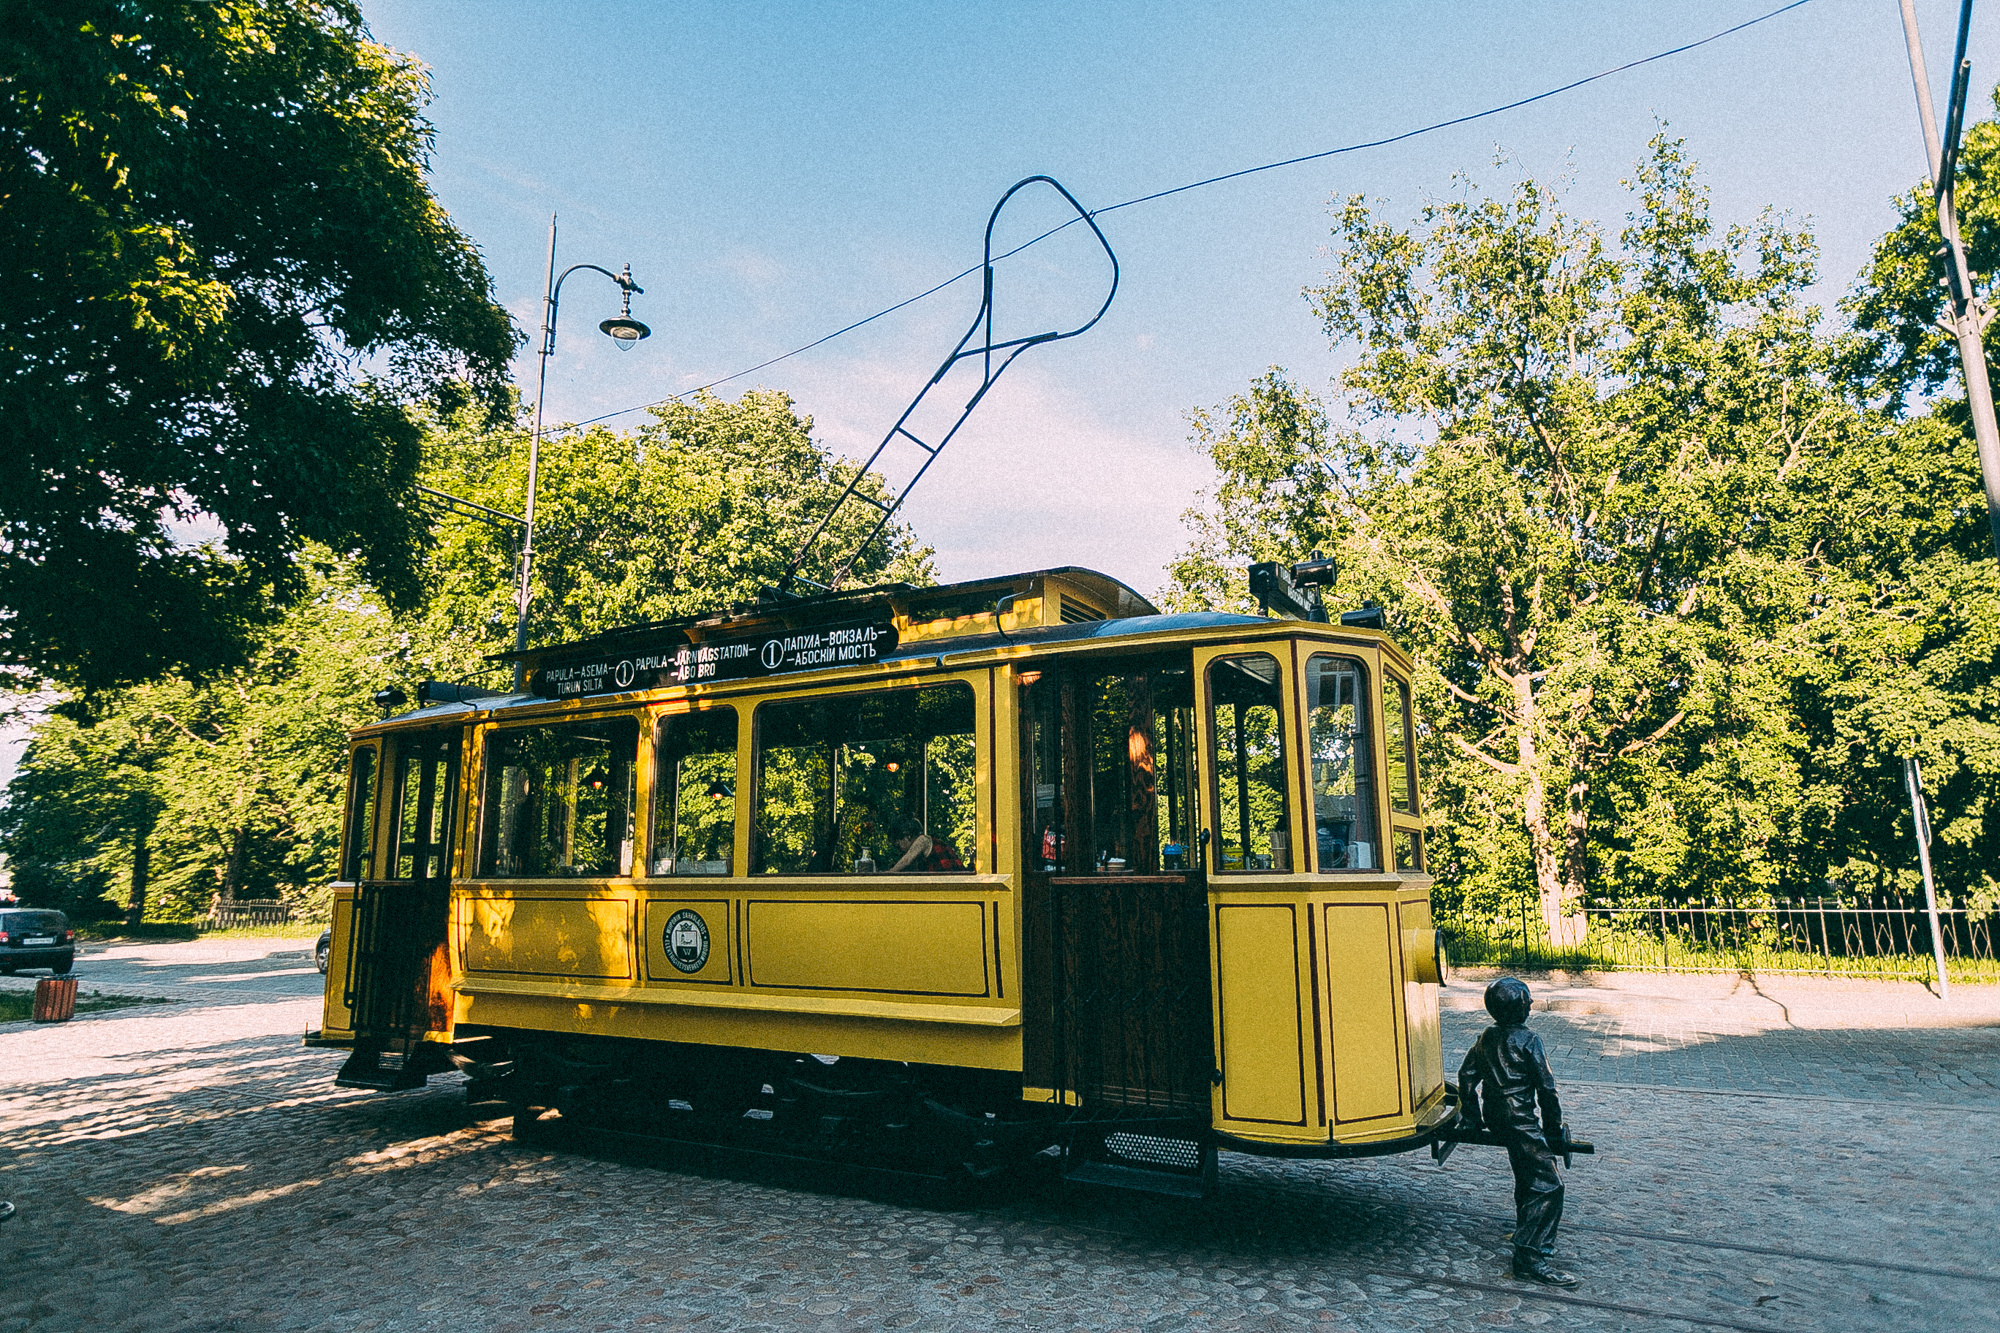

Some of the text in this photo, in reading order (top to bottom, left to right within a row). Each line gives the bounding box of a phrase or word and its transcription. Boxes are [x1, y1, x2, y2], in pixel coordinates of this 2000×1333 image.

[838, 643, 877, 660] МОСТЪ
[697, 662, 716, 679] BRO
[557, 677, 604, 695] TURUN SILTA
[683, 948, 692, 956] W
